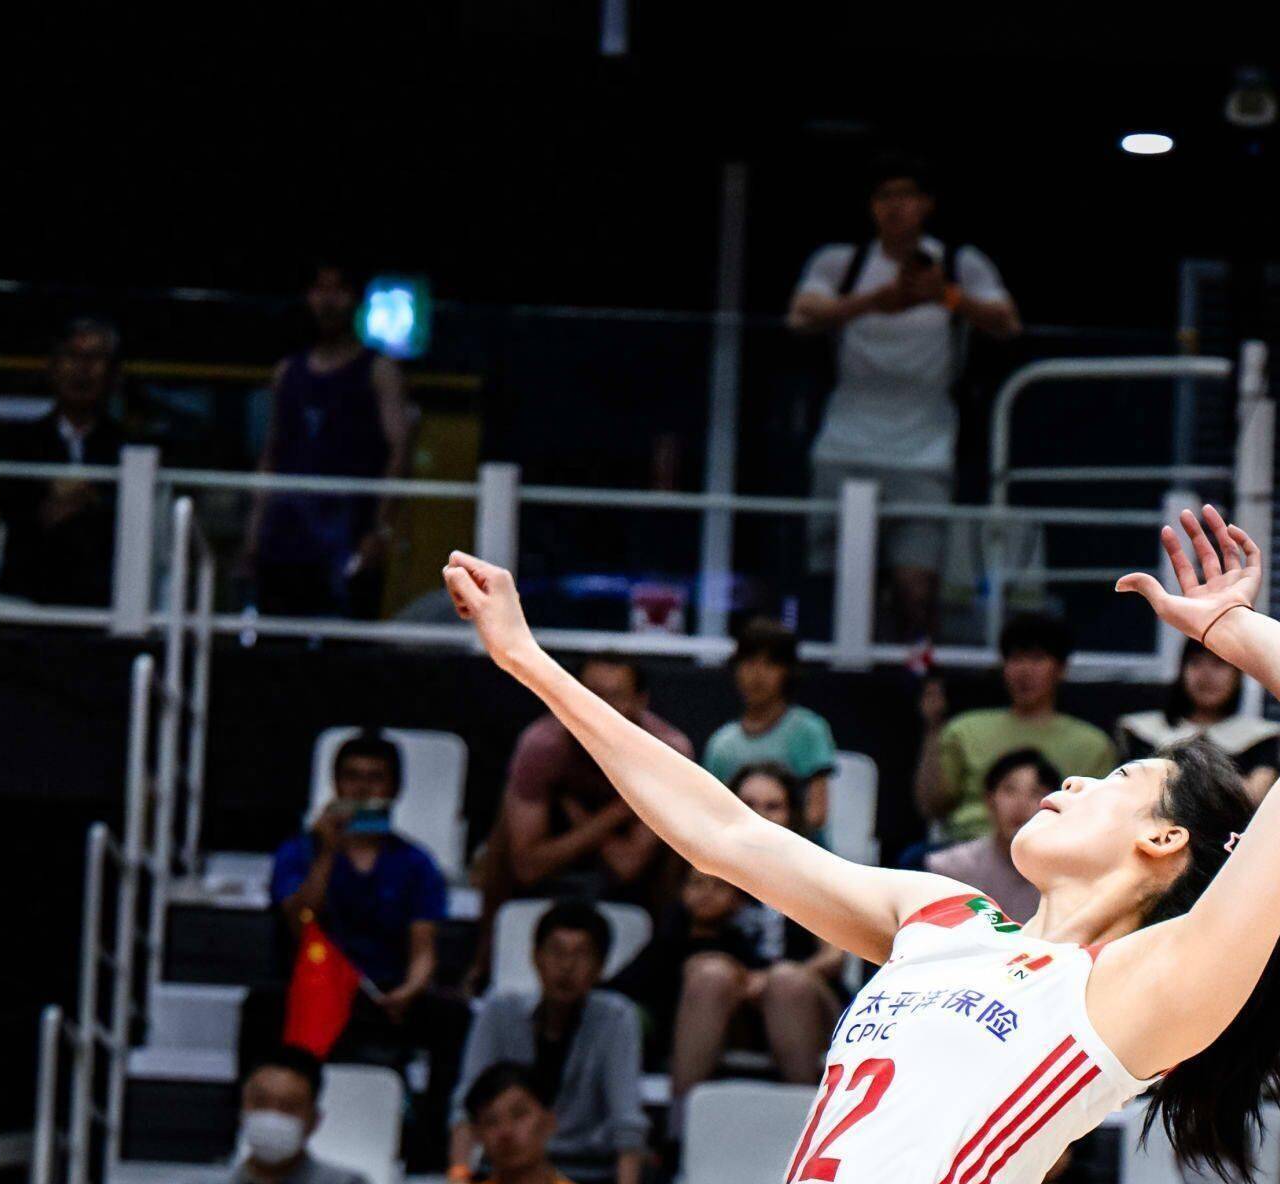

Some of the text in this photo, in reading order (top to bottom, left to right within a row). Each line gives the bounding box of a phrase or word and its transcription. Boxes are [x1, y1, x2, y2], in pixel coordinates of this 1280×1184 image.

[845, 1022, 897, 1043] CPIC
[856, 988, 1019, 1043] 太平洋保险
